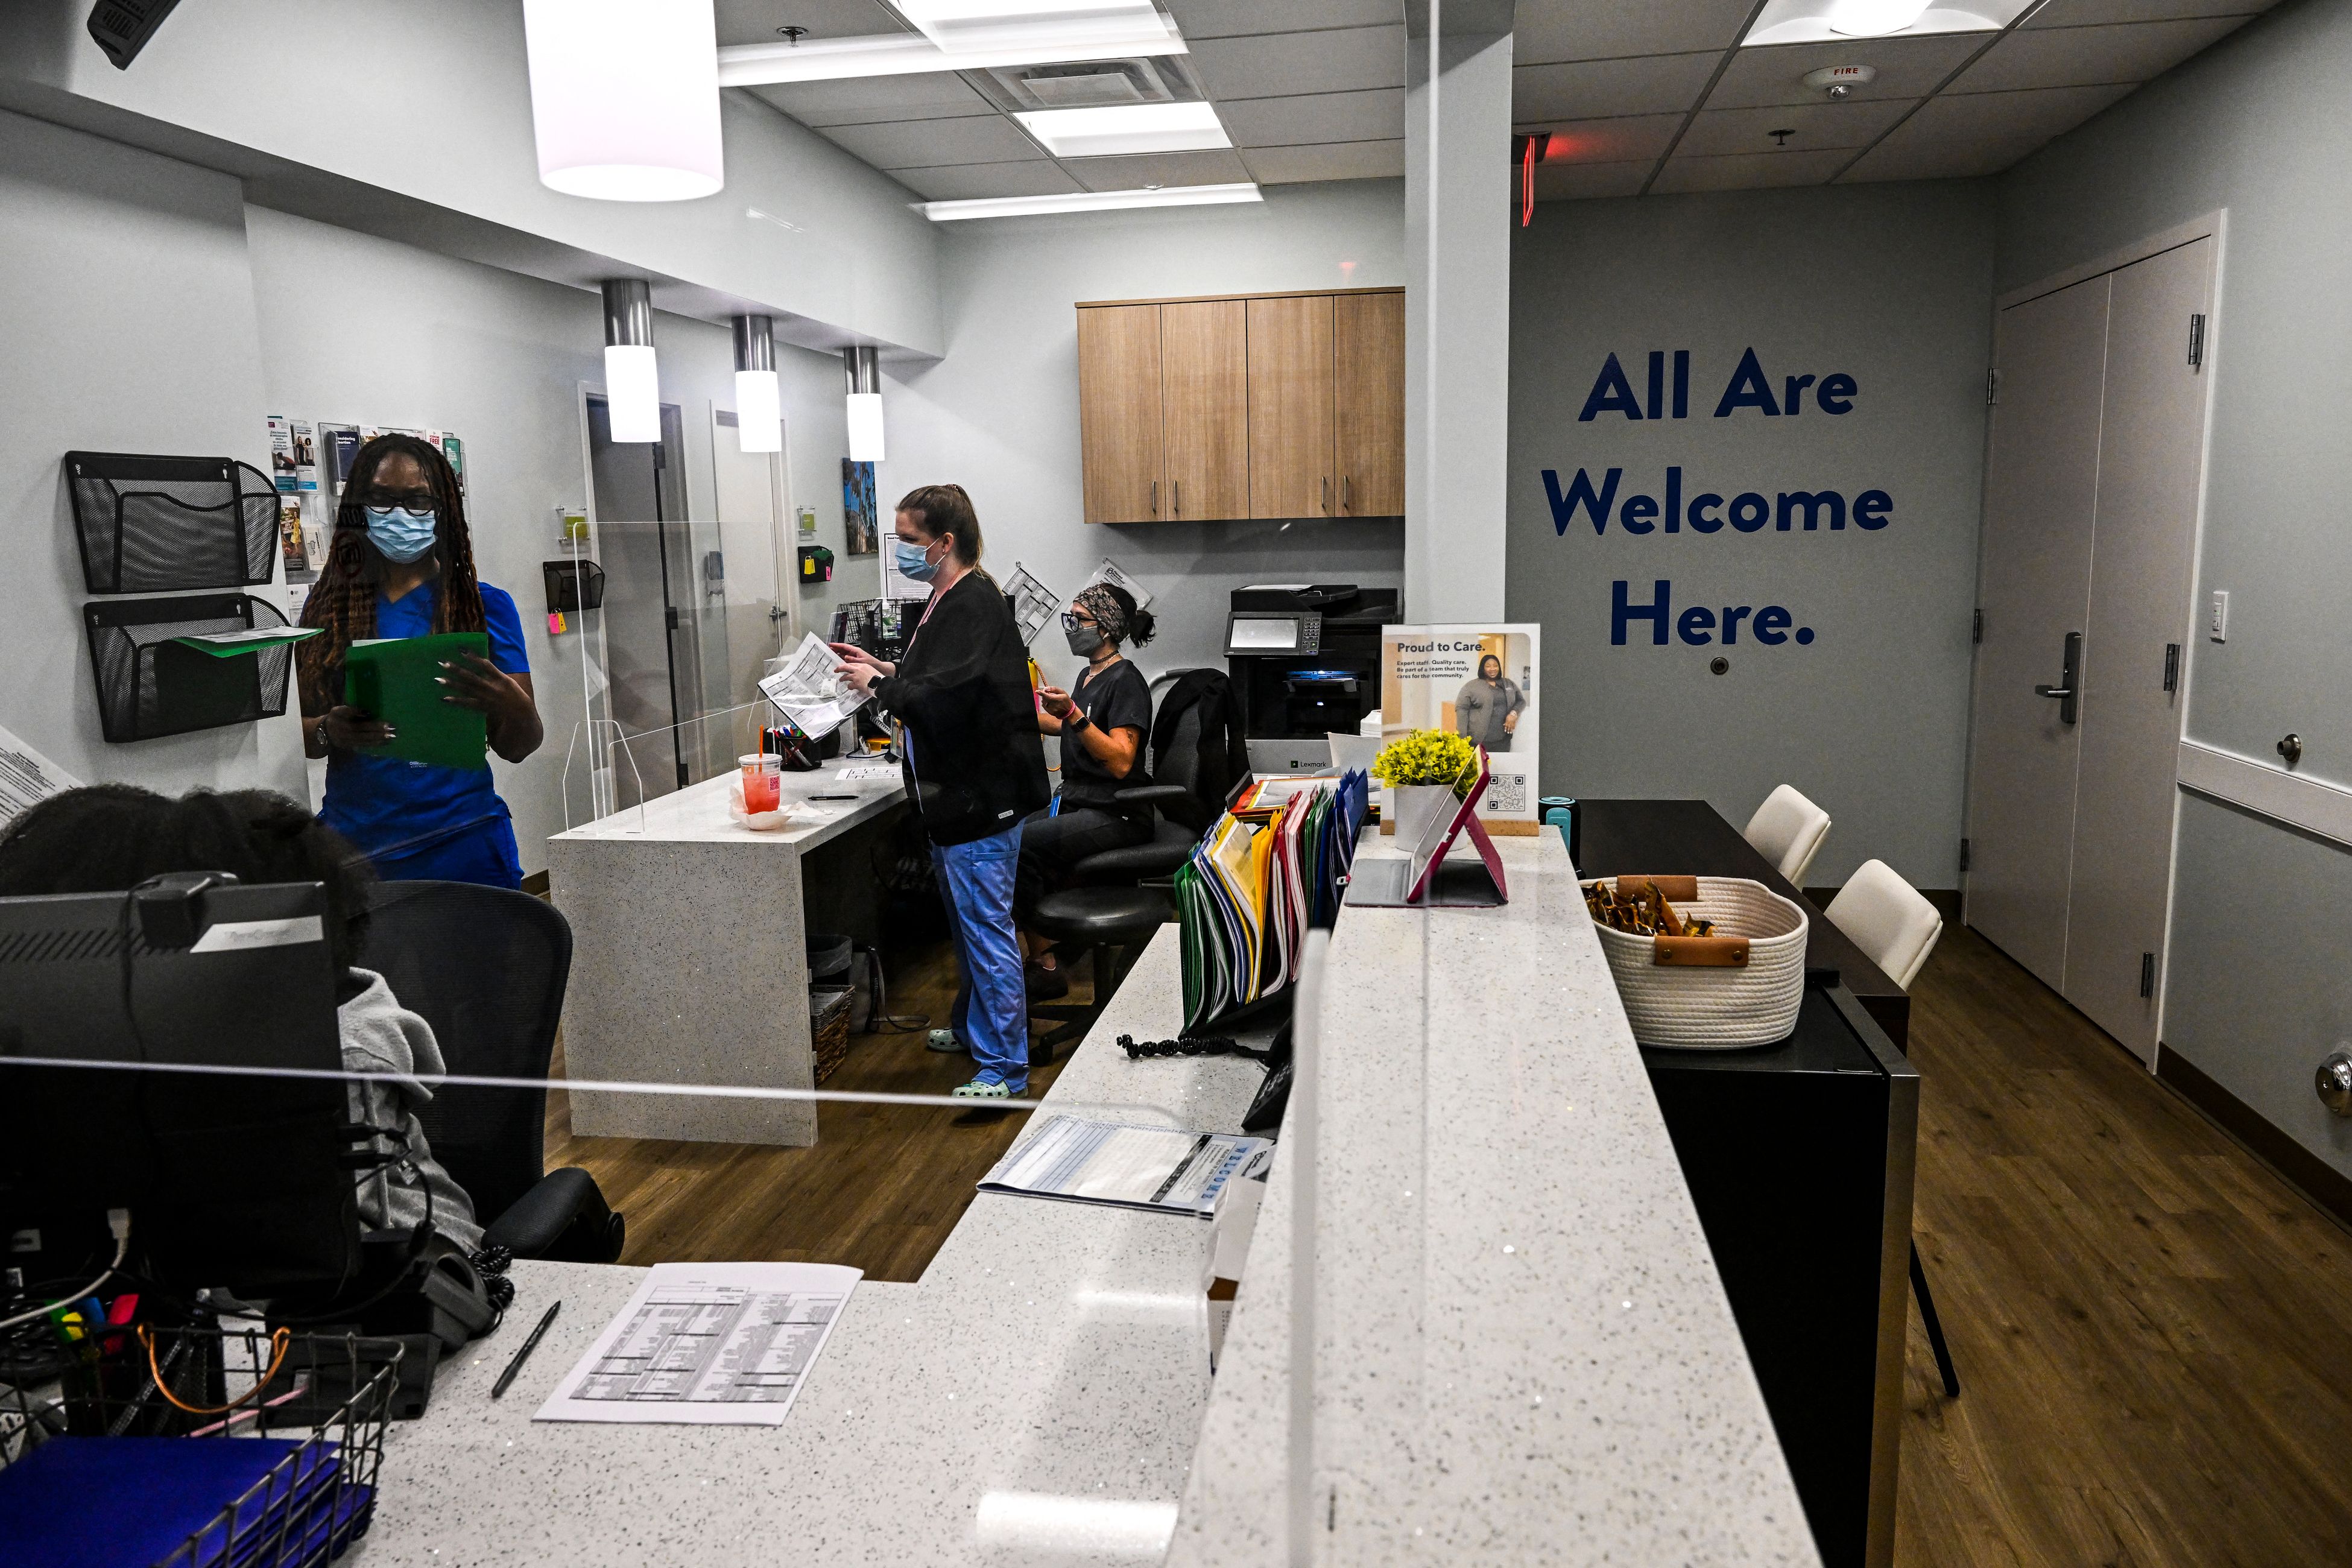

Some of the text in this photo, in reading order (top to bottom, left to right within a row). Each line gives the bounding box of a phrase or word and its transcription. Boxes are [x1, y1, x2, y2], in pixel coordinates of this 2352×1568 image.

[1578, 347, 1857, 422] All Are
[1541, 466, 1893, 536] Welcome
[1611, 580, 1815, 646] Here.
[1397, 642, 1485, 653] Proud to Care.
